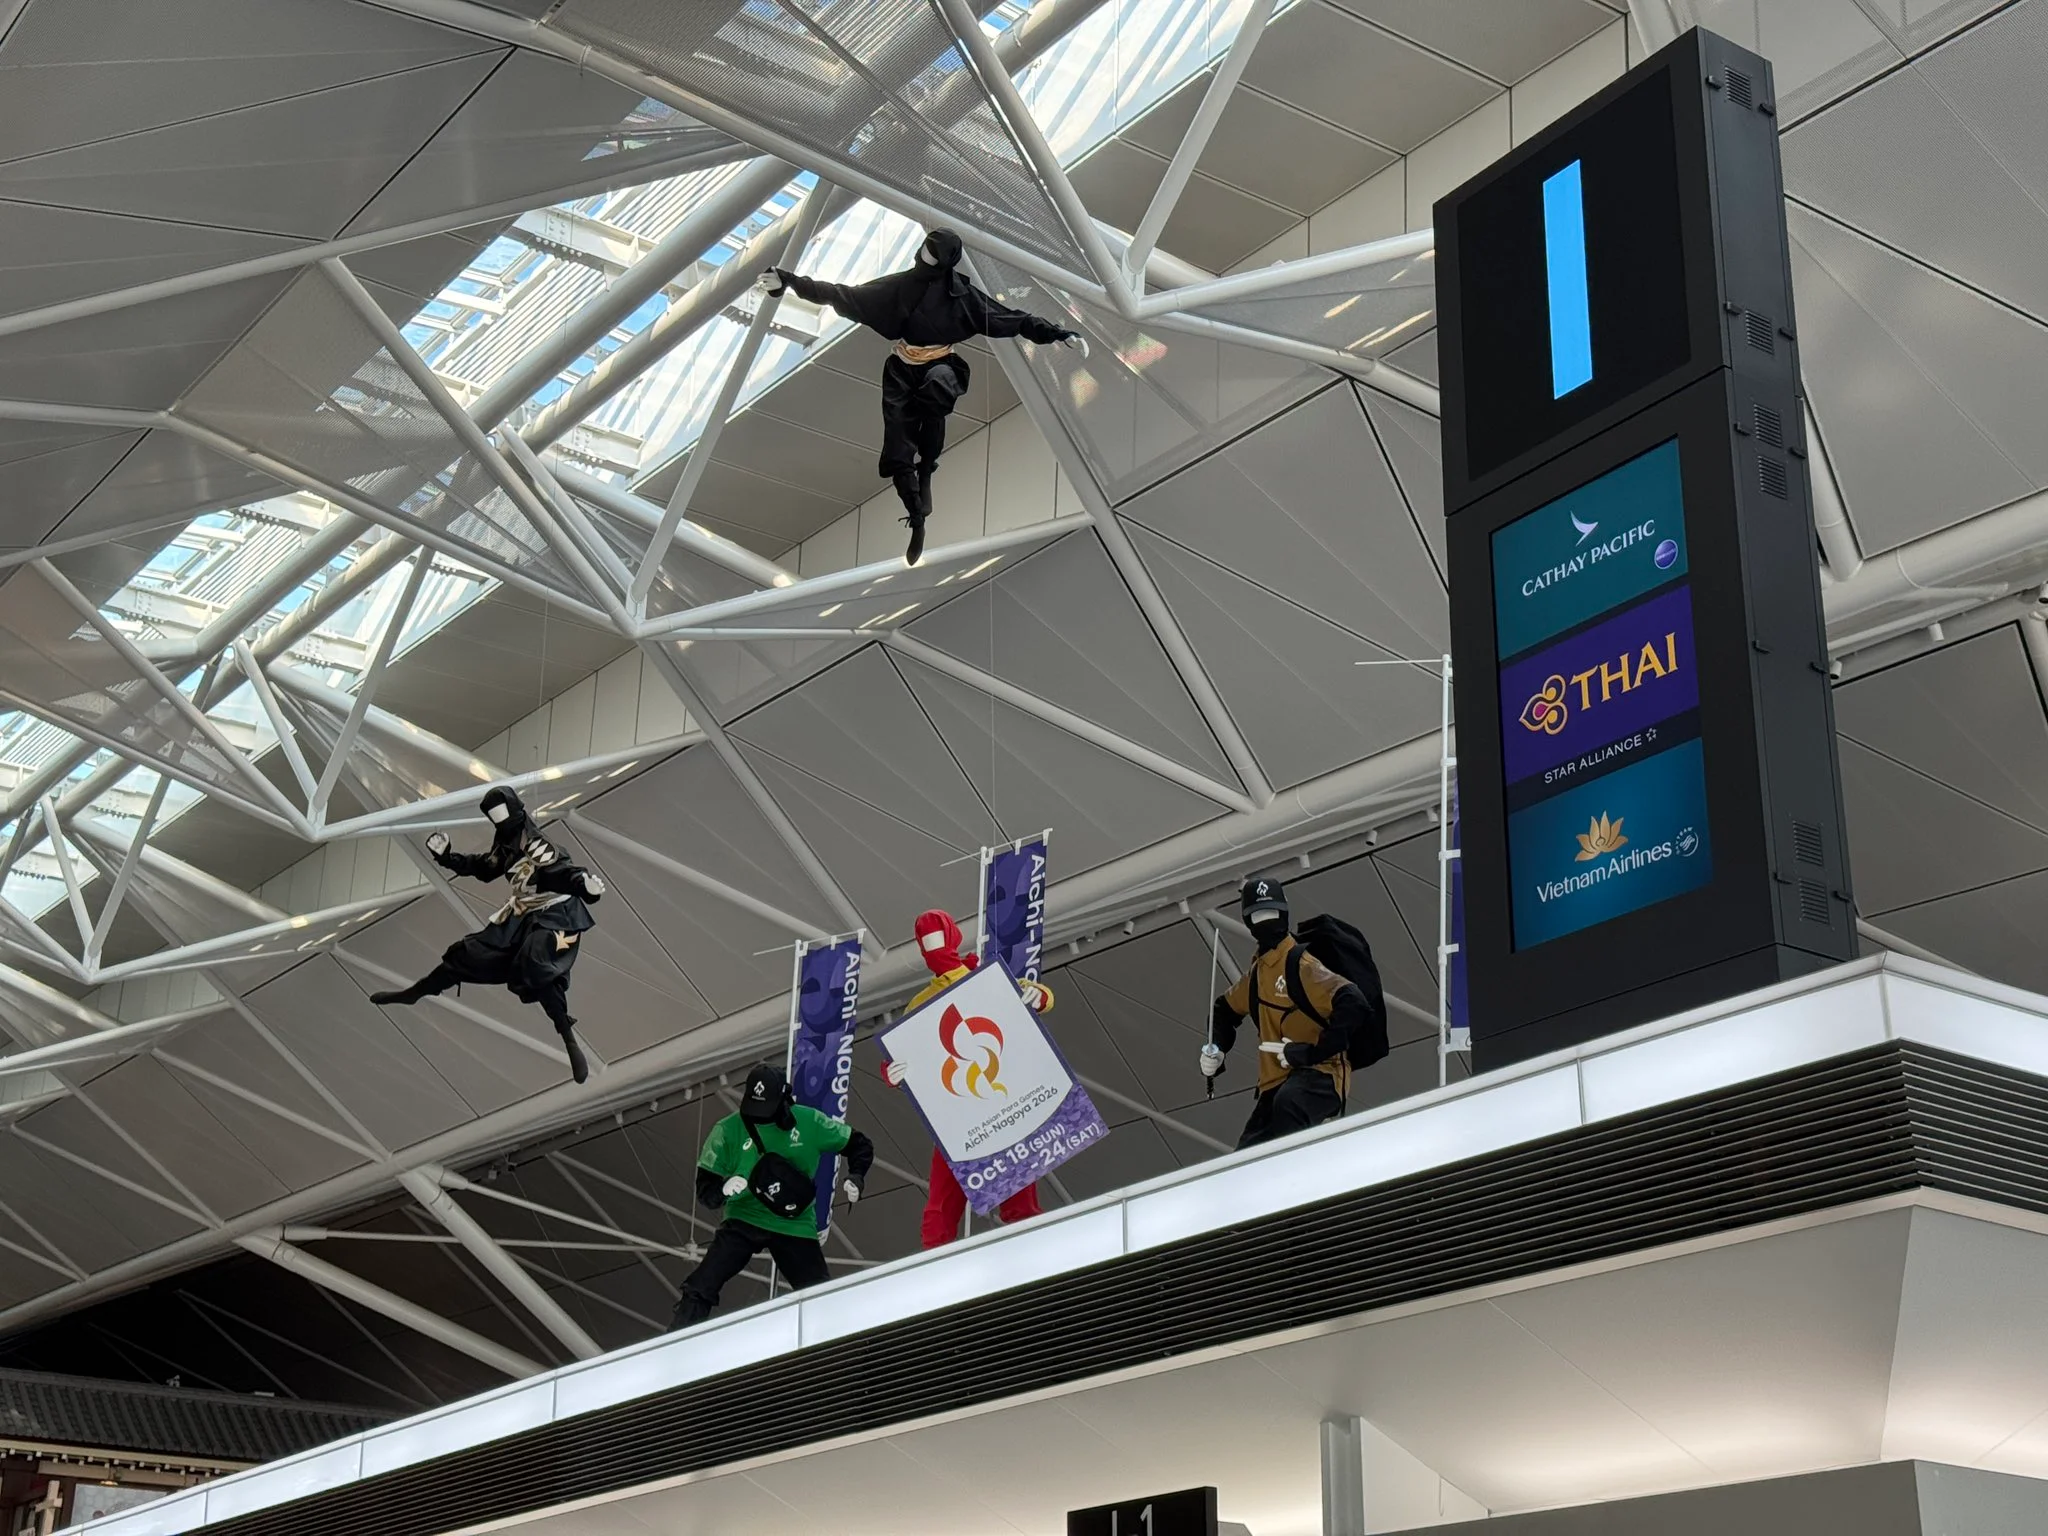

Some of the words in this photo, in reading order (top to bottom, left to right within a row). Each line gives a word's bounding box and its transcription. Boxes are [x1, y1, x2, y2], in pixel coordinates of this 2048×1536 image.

[1521, 552, 1588, 597] CATHAY
[1590, 519, 1656, 564] PACIFIC
[1569, 632, 1678, 711] THAI
[1544, 762, 1576, 784] STAR
[1579, 734, 1643, 770] ALLIANCE
[1536, 865, 1606, 903] Vietnam
[1607, 841, 1672, 879] Airlines
[964, 1104, 1032, 1153] Aichi-Nagoya
[1031, 1086, 1058, 1108] 2026
[981, 1110, 1001, 1127] Asian
[1001, 1101, 1019, 1116] Para
[1019, 1084, 1045, 1103] Games
[967, 1157, 1008, 1190] Oct
